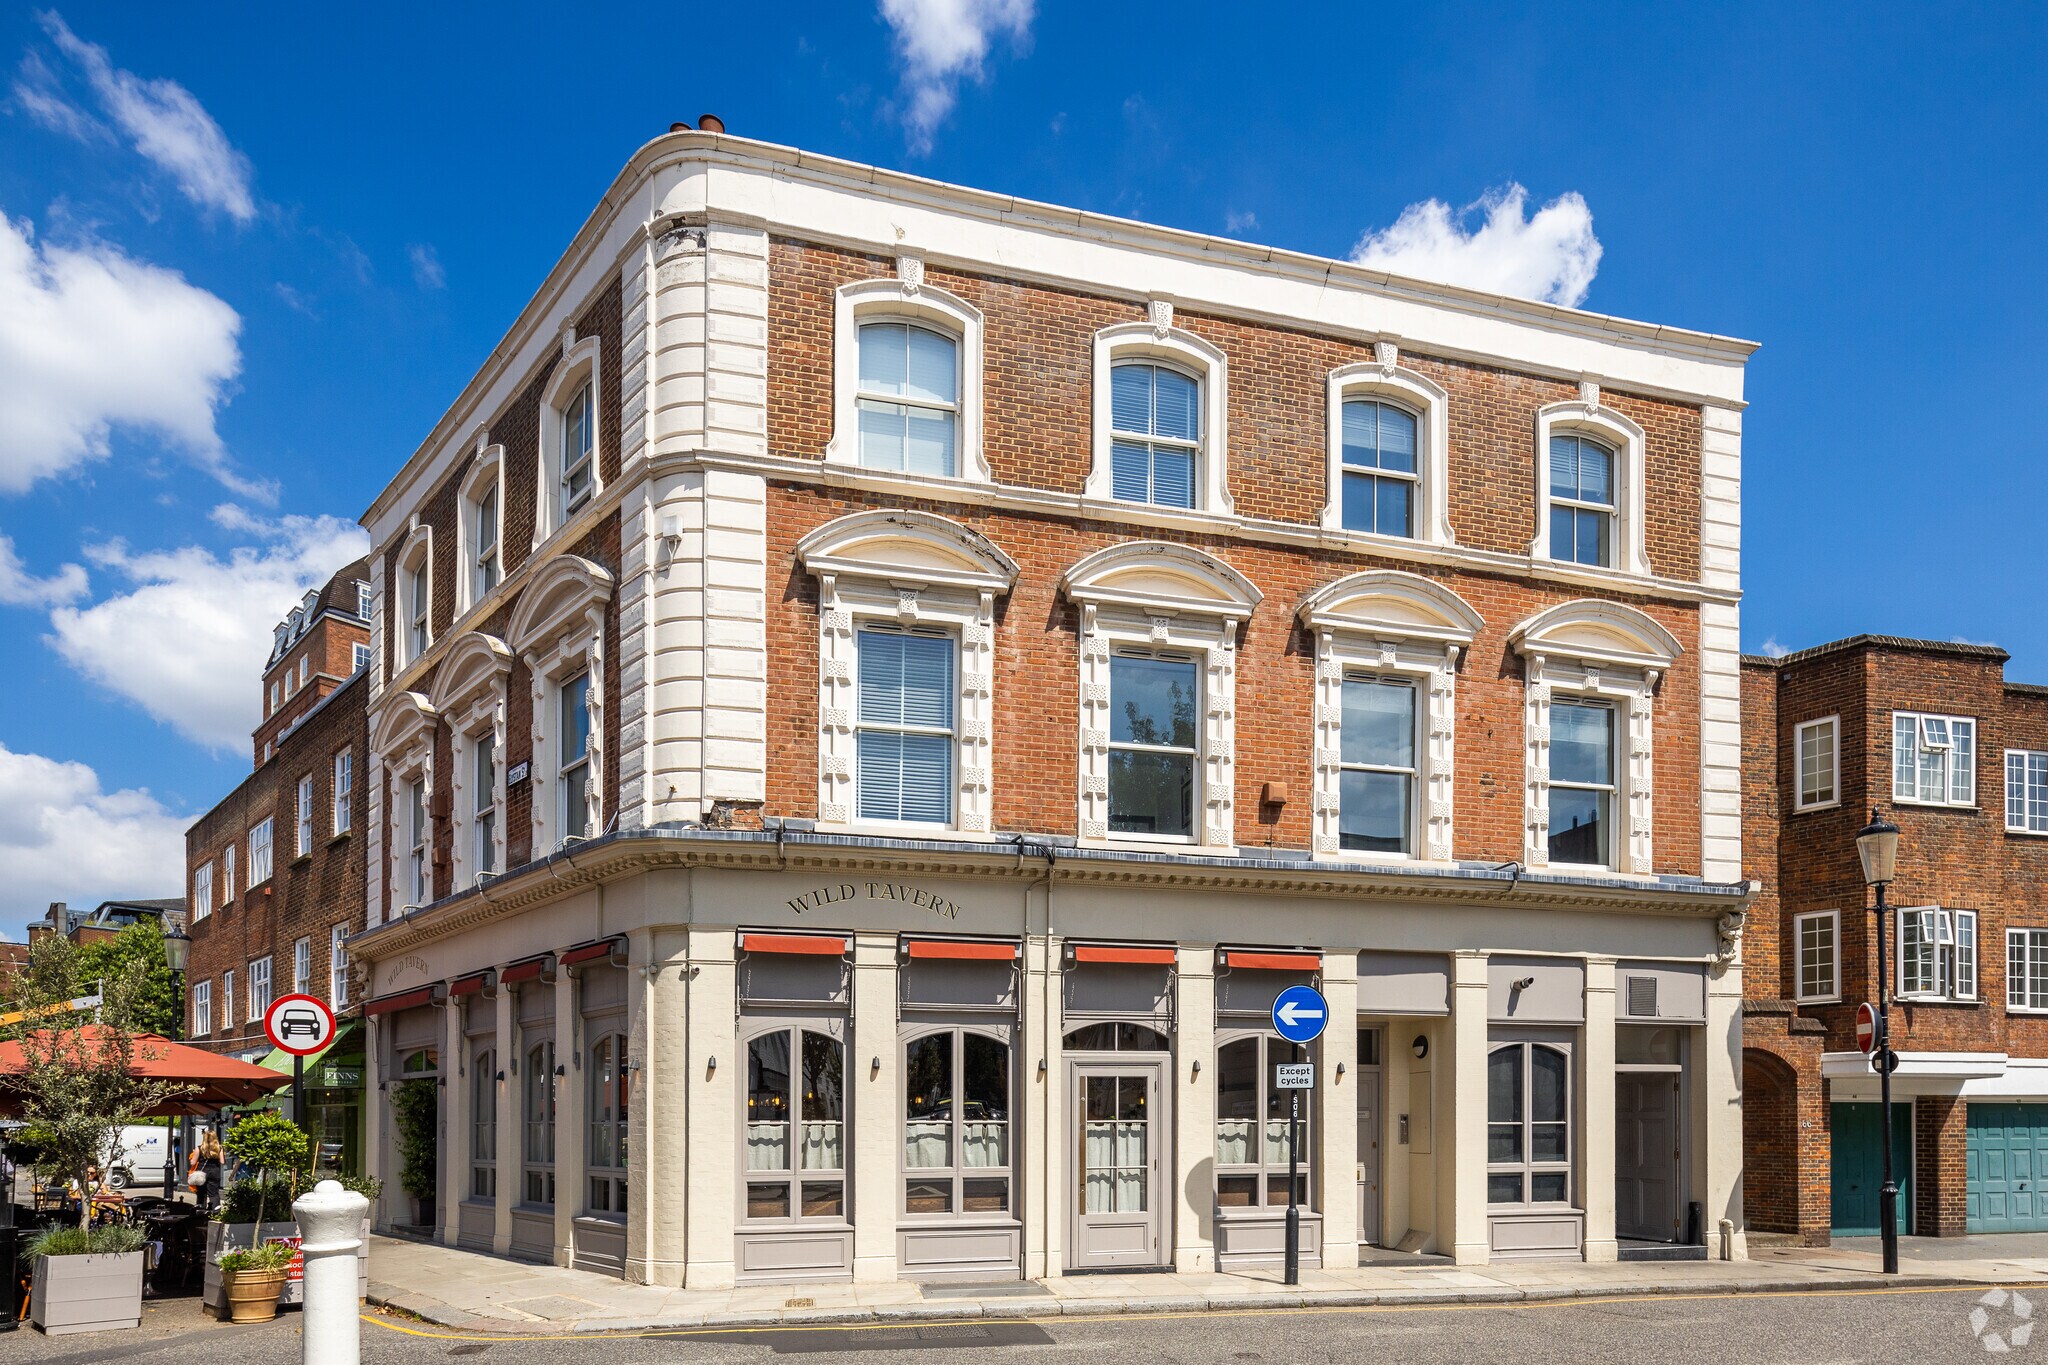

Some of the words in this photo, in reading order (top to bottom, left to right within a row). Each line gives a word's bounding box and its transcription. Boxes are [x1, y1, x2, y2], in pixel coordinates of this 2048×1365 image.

[786, 883, 856, 916] WILD
[864, 882, 961, 921] TAVERN
[388, 961, 404, 987] WILD
[405, 955, 430, 977] TAVERN
[327, 1072, 359, 1080] FINNS
[1280, 1067, 1310, 1076] Except
[1281, 1076, 1309, 1085] cycles
